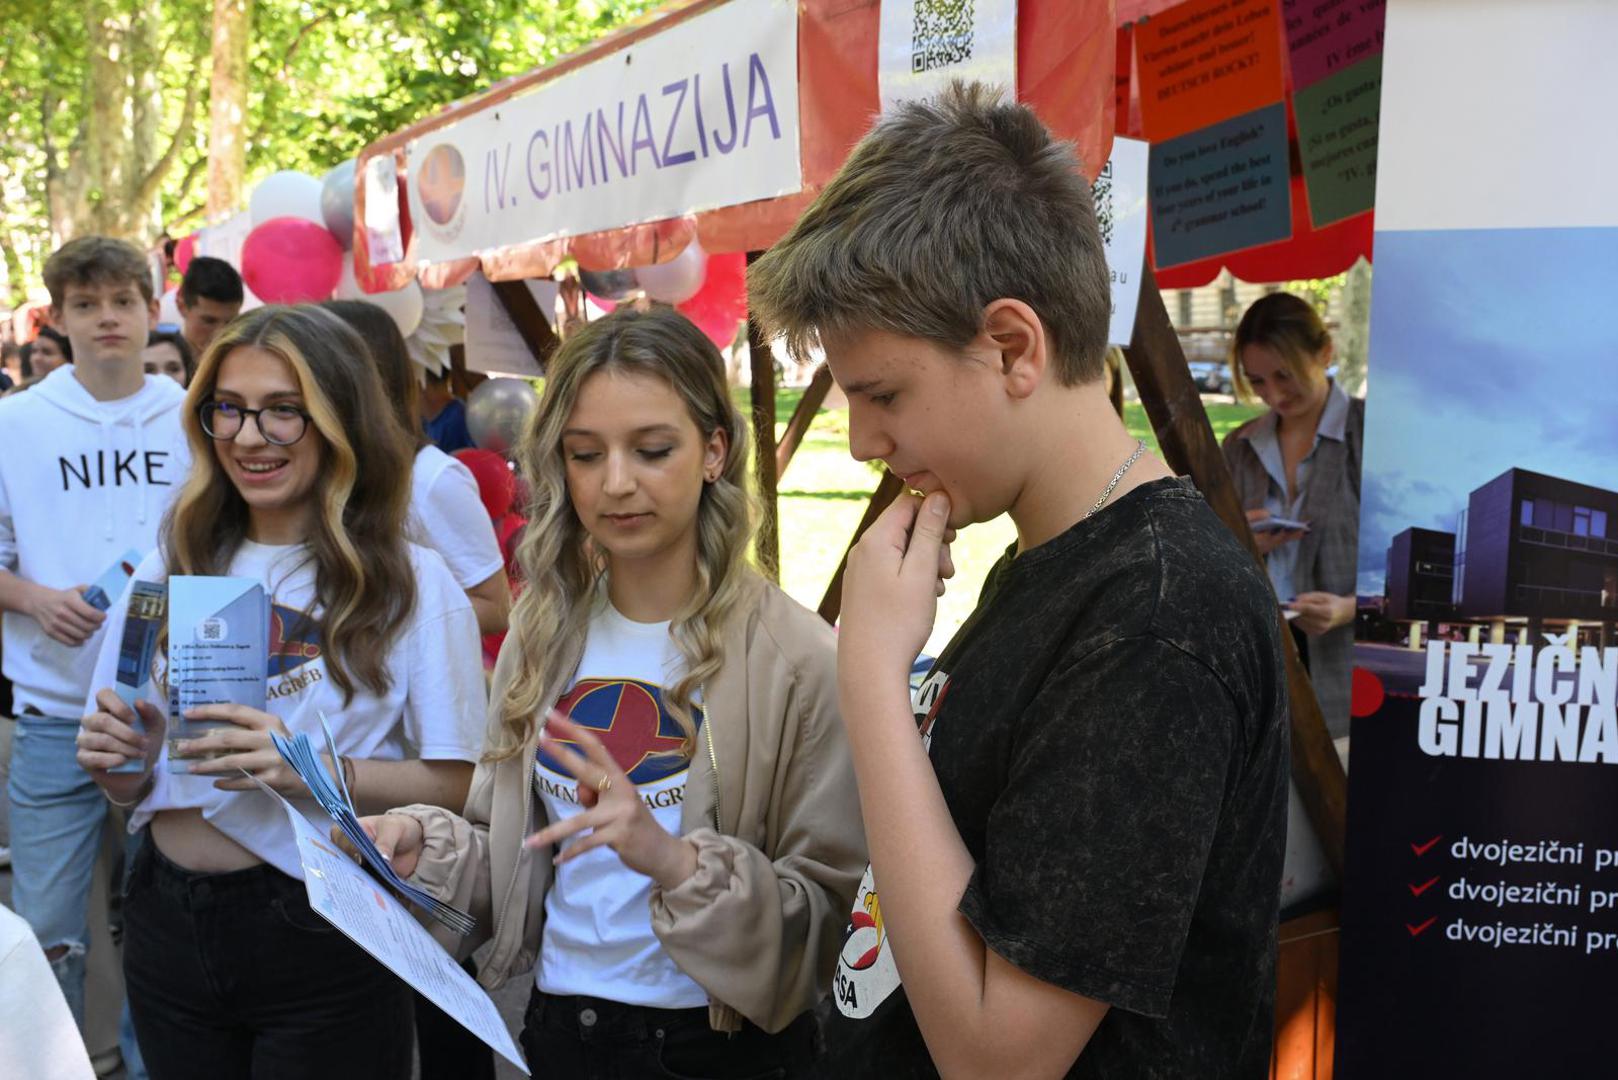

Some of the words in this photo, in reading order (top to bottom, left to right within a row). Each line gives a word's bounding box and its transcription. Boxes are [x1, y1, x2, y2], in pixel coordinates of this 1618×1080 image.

[485, 142, 517, 213] IV.
[527, 52, 782, 200] GIMNAZIJA
[58, 450, 172, 491] NIKE
[1418, 696, 1618, 764] GIMNA
[1451, 836, 1584, 867] dvojezični
[1449, 877, 1580, 908] dvojezični
[1446, 918, 1578, 949] dvojezični
[1586, 931, 1618, 955] pr
